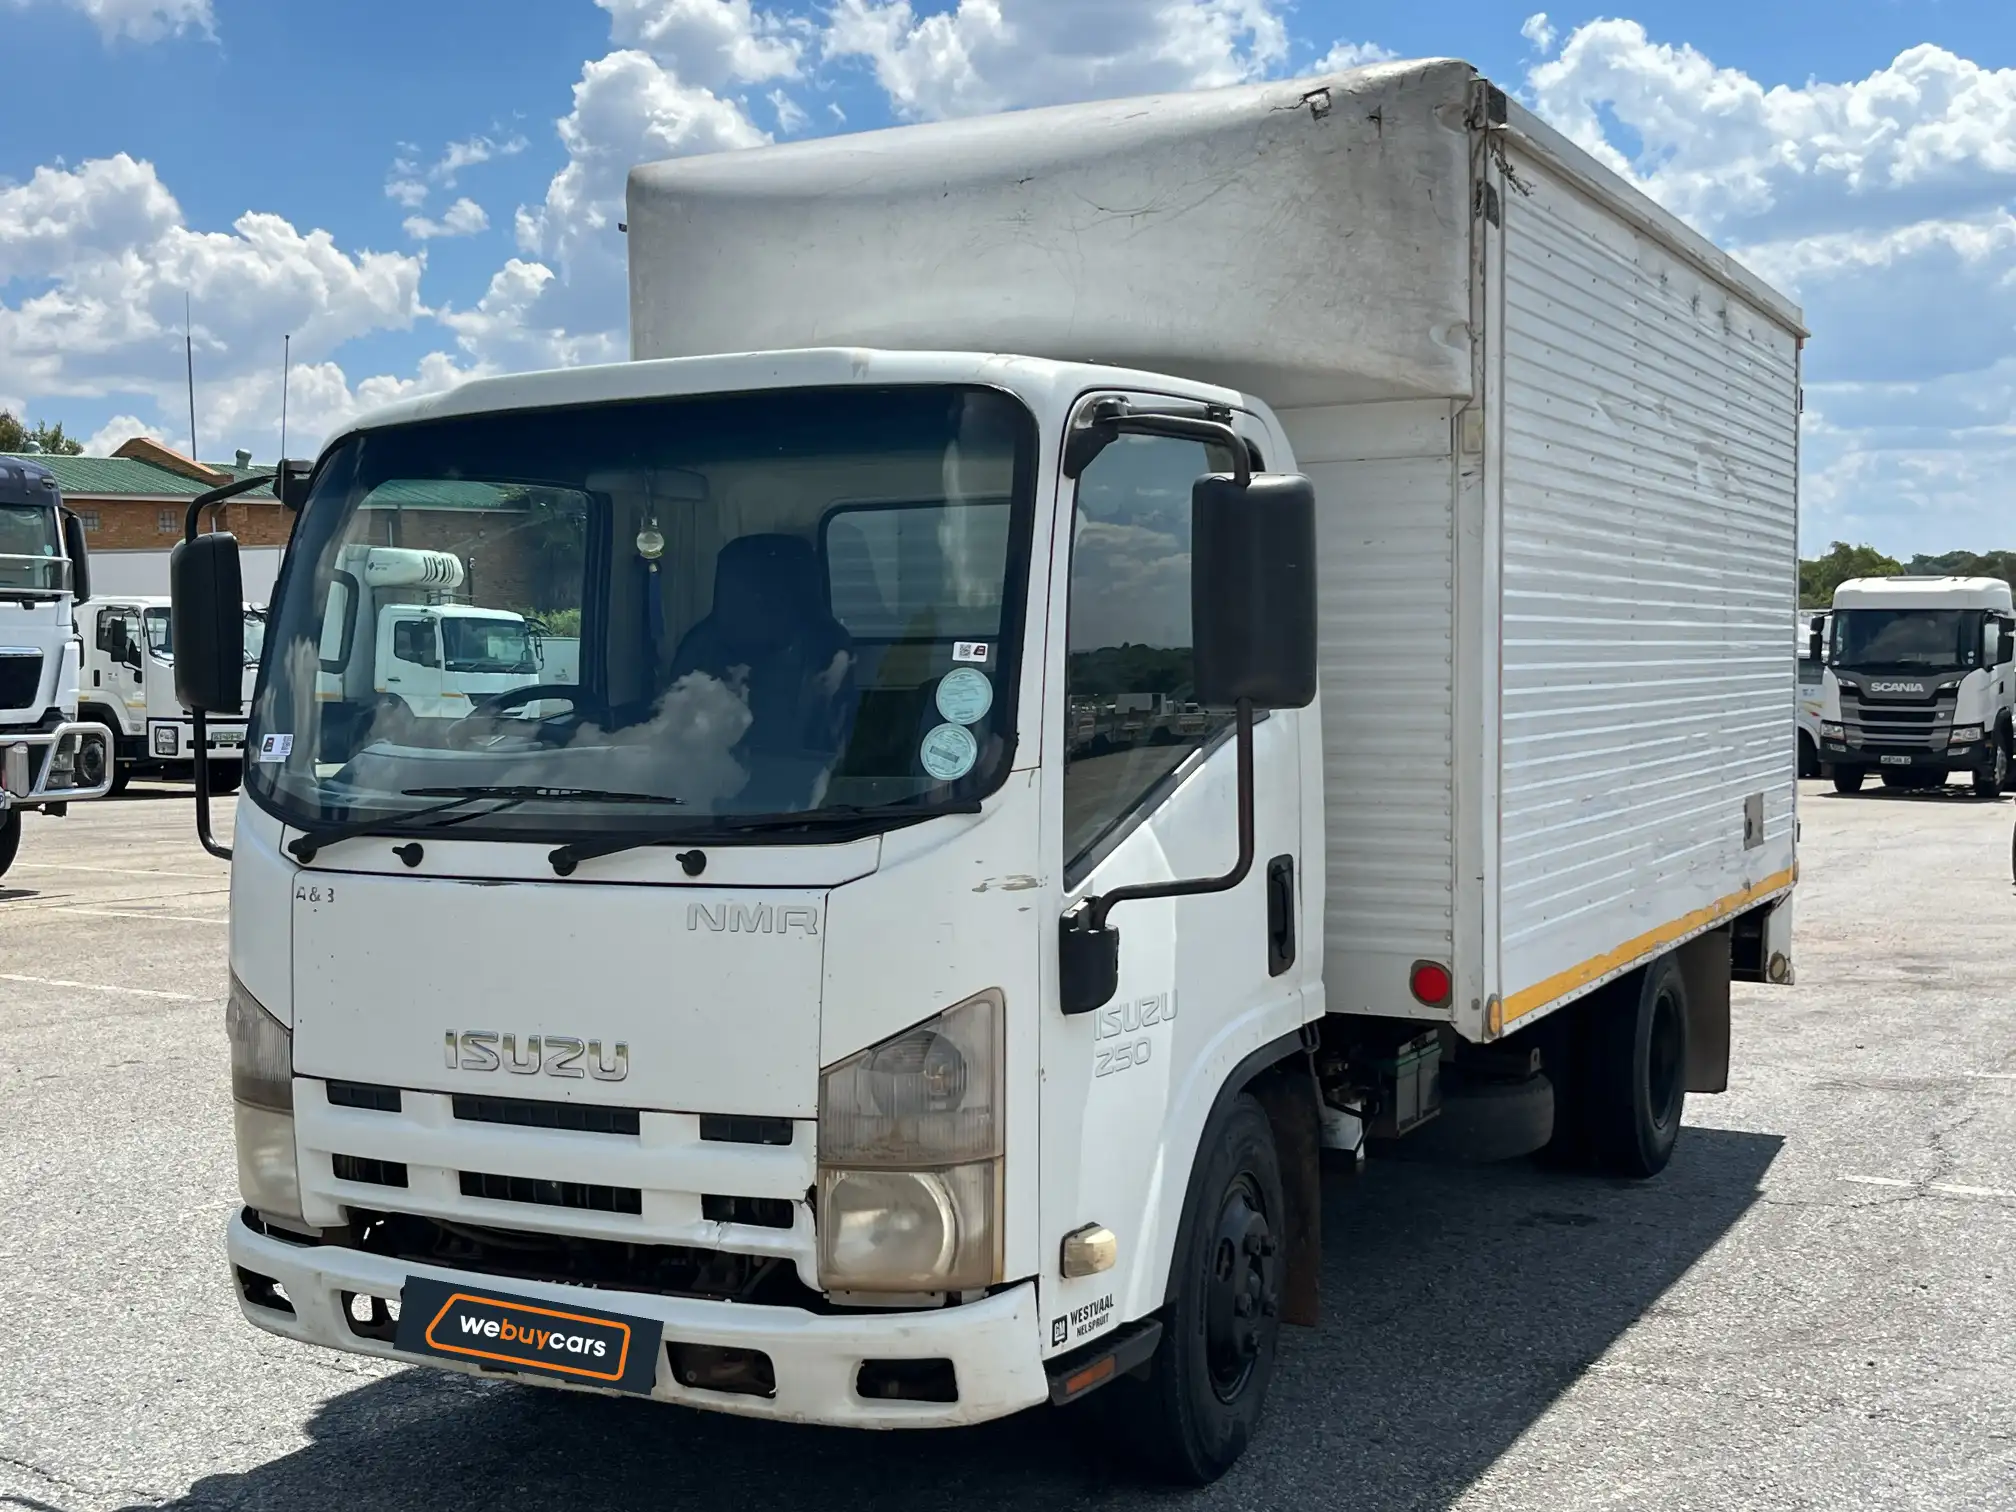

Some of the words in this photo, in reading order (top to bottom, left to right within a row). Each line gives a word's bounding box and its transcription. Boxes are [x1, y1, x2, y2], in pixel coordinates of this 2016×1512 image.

[1871, 682, 1924, 692] SCANIA
[687, 903, 818, 935] NMR
[1094, 989, 1178, 1041] ISUZU
[444, 1028, 629, 1082] ISUZU
[1095, 1037, 1151, 1078] 250
[1070, 1293, 1114, 1326] WESTVAAL
[1076, 1312, 1109, 1337] NELSPRUIT
